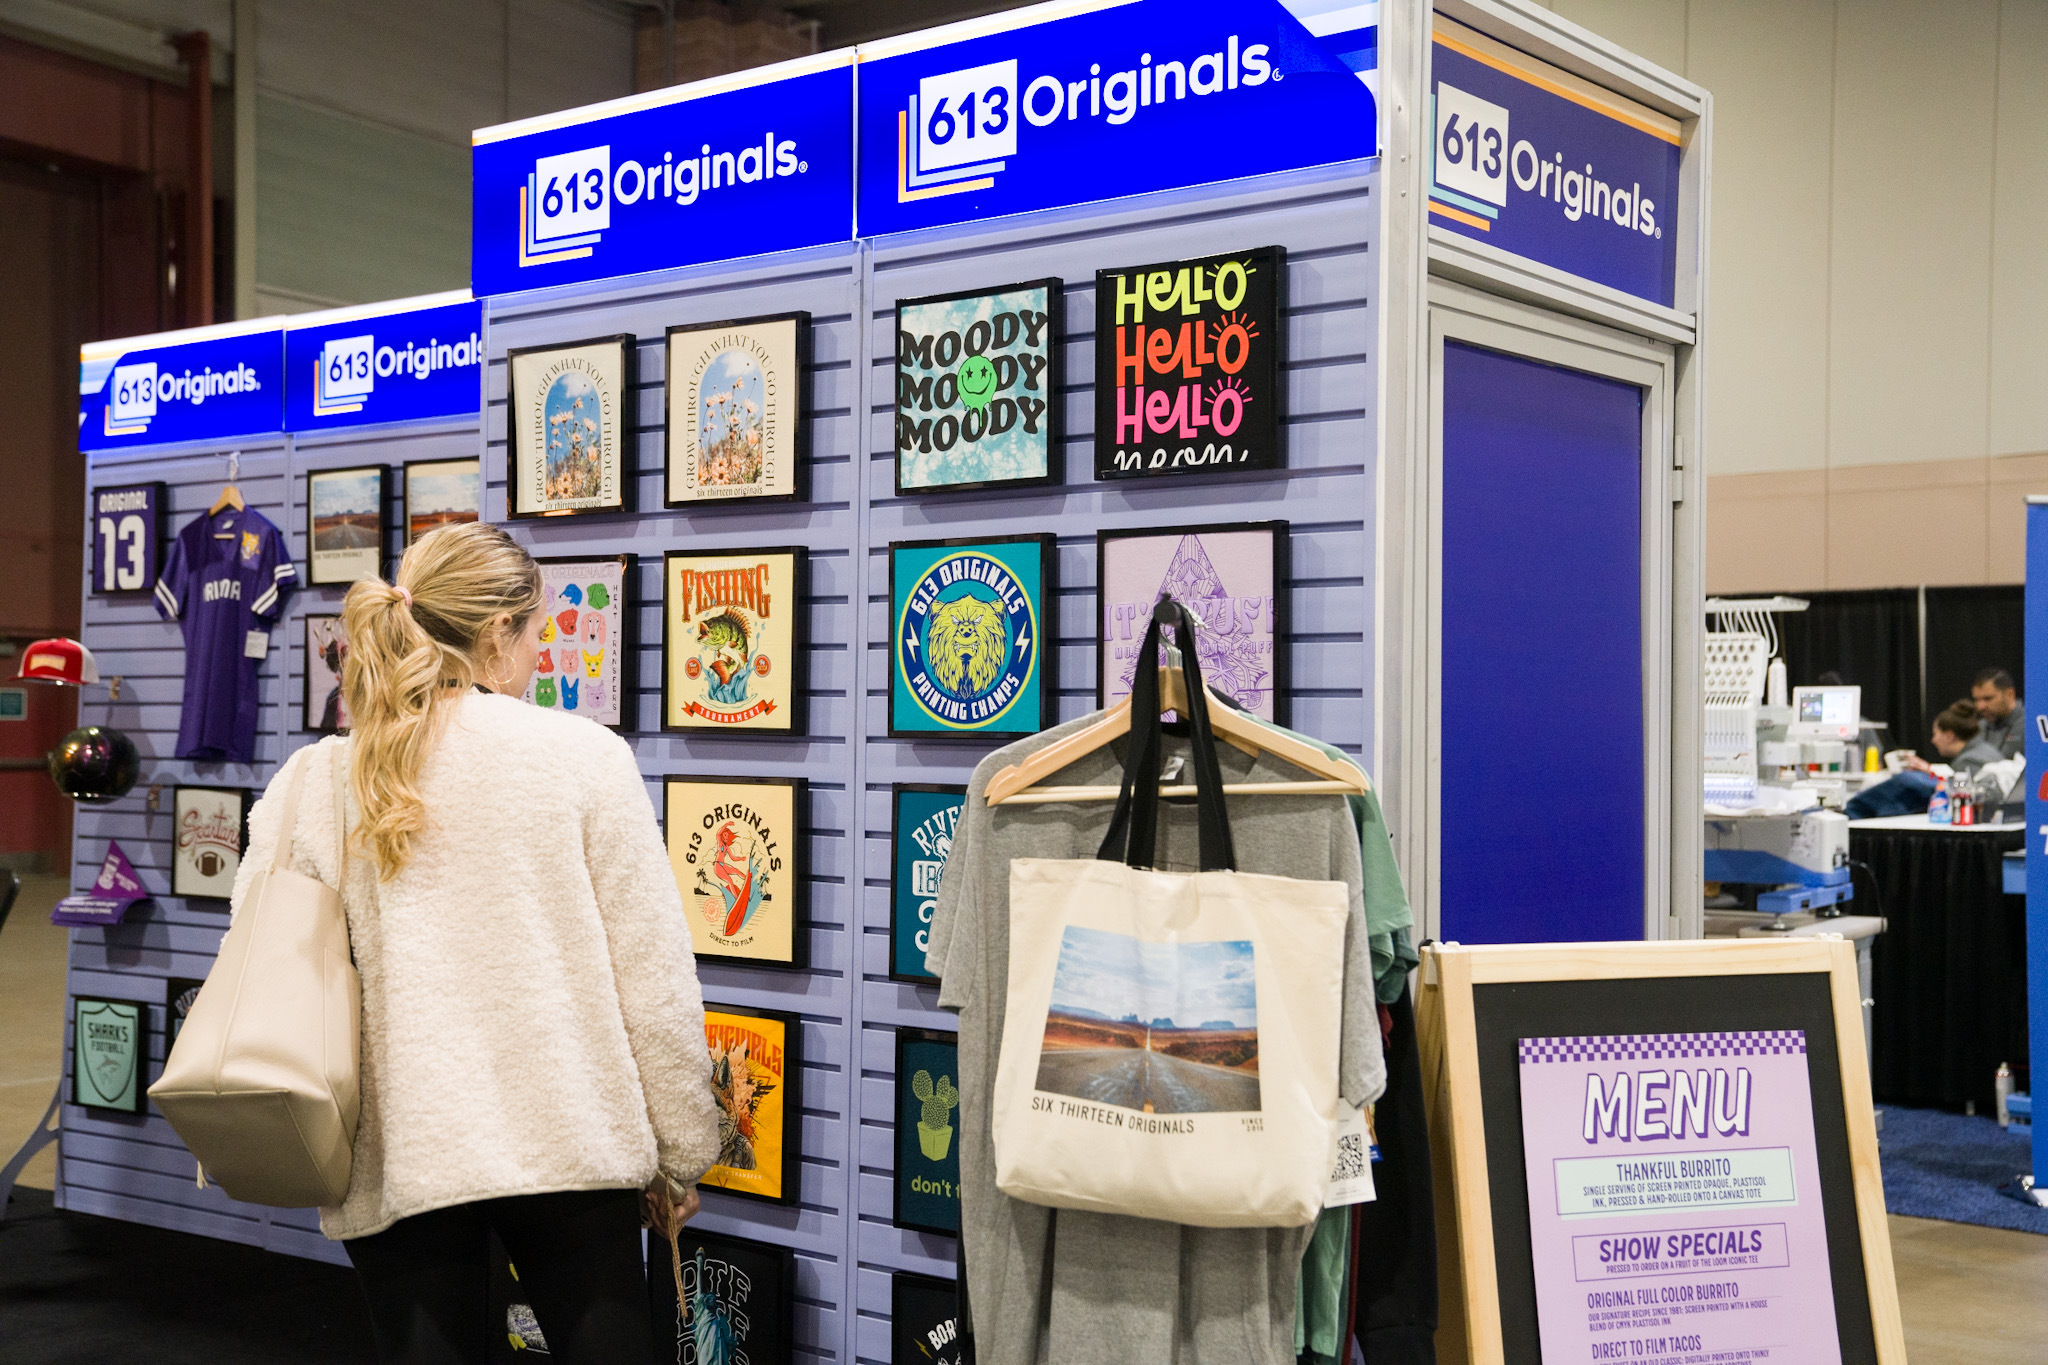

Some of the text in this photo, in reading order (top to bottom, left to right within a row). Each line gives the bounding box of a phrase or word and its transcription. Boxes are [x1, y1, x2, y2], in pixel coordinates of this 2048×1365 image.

[928, 86, 1009, 145] 613
[1442, 113, 1502, 179] 613
[542, 168, 604, 218] 613
[900, 309, 1048, 370] MOODY
[330, 350, 369, 384] 613
[119, 376, 153, 407] 613
[686, 334, 777, 489] GROW THROUGH WHAT YOU GO THROUGH
[900, 396, 1046, 454] MOODY
[534, 358, 612, 504] GROW THROUGH WHAT YOU GO THROUGH
[100, 514, 146, 591] 13
[681, 563, 771, 623] FISHING
[910, 559, 1025, 616] 613 ORIGINALS
[912, 672, 1020, 721] PRINTING CHAMPS
[700, 705, 761, 723] TOURNAMENT
[686, 803, 782, 872] 613 ORIGINALS
[709, 932, 730, 946] DIRECT
[741, 936, 754, 946] FILM
[88, 1022, 128, 1042] SHARKS
[1031, 1096, 1195, 1134] SIX THIRTEEN ORIGINALS
[1582, 1067, 1751, 1145] MENU
[911, 1175, 952, 1198] don't
[1583, 1186, 1606, 1197] SINGLE
[1607, 1184, 1636, 1195] SERVING
[1637, 1183, 1646, 1193] OF
[1647, 1181, 1672, 1192] SCREEN
[1674, 1180, 1701, 1191] PRINTED
[1733, 1176, 1766, 1188] PLASTISOL
[1617, 1158, 1731, 1182] THANKFUL BURRITO
[1592, 1188, 1762, 1208] INK, PRESSED & HAND-ROLLED ONTO A CANVAS TOTE
[1600, 1230, 1762, 1262] SHOW SPECIALS
[1606, 1255, 1759, 1273] PRESSED TO ORDER ON A FRUIT OF THE LOOM ICONIC TEE
[1587, 1282, 1739, 1309] ORIGINAL FULL COLOR BURRITO
[1588, 1313, 1600, 1322] OUR
[1601, 1309, 1631, 1320] SIGNATURE
[1632, 1308, 1651, 1318] RECIPE
[1652, 1307, 1668, 1316] SINCE
[1684, 1304, 1705, 1314] SCREEN
[1706, 1302, 1729, 1312] PRINTED
[1730, 1301, 1744, 1311] WITH
[1745, 1301, 1750, 1309] A
[1750, 1299, 1768, 1309] HOUSE
[1589, 1317, 1671, 1332] BLEND OF CMYK PLASTISOL INK
[1592, 1334, 1702, 1360] DIRECT TO FILM TACOS
[1685, 1353, 1710, 1364] DIGITALLY
[1711, 1352, 1734, 1362] PRINTED
[1735, 1351, 1750, 1360] ONTO
